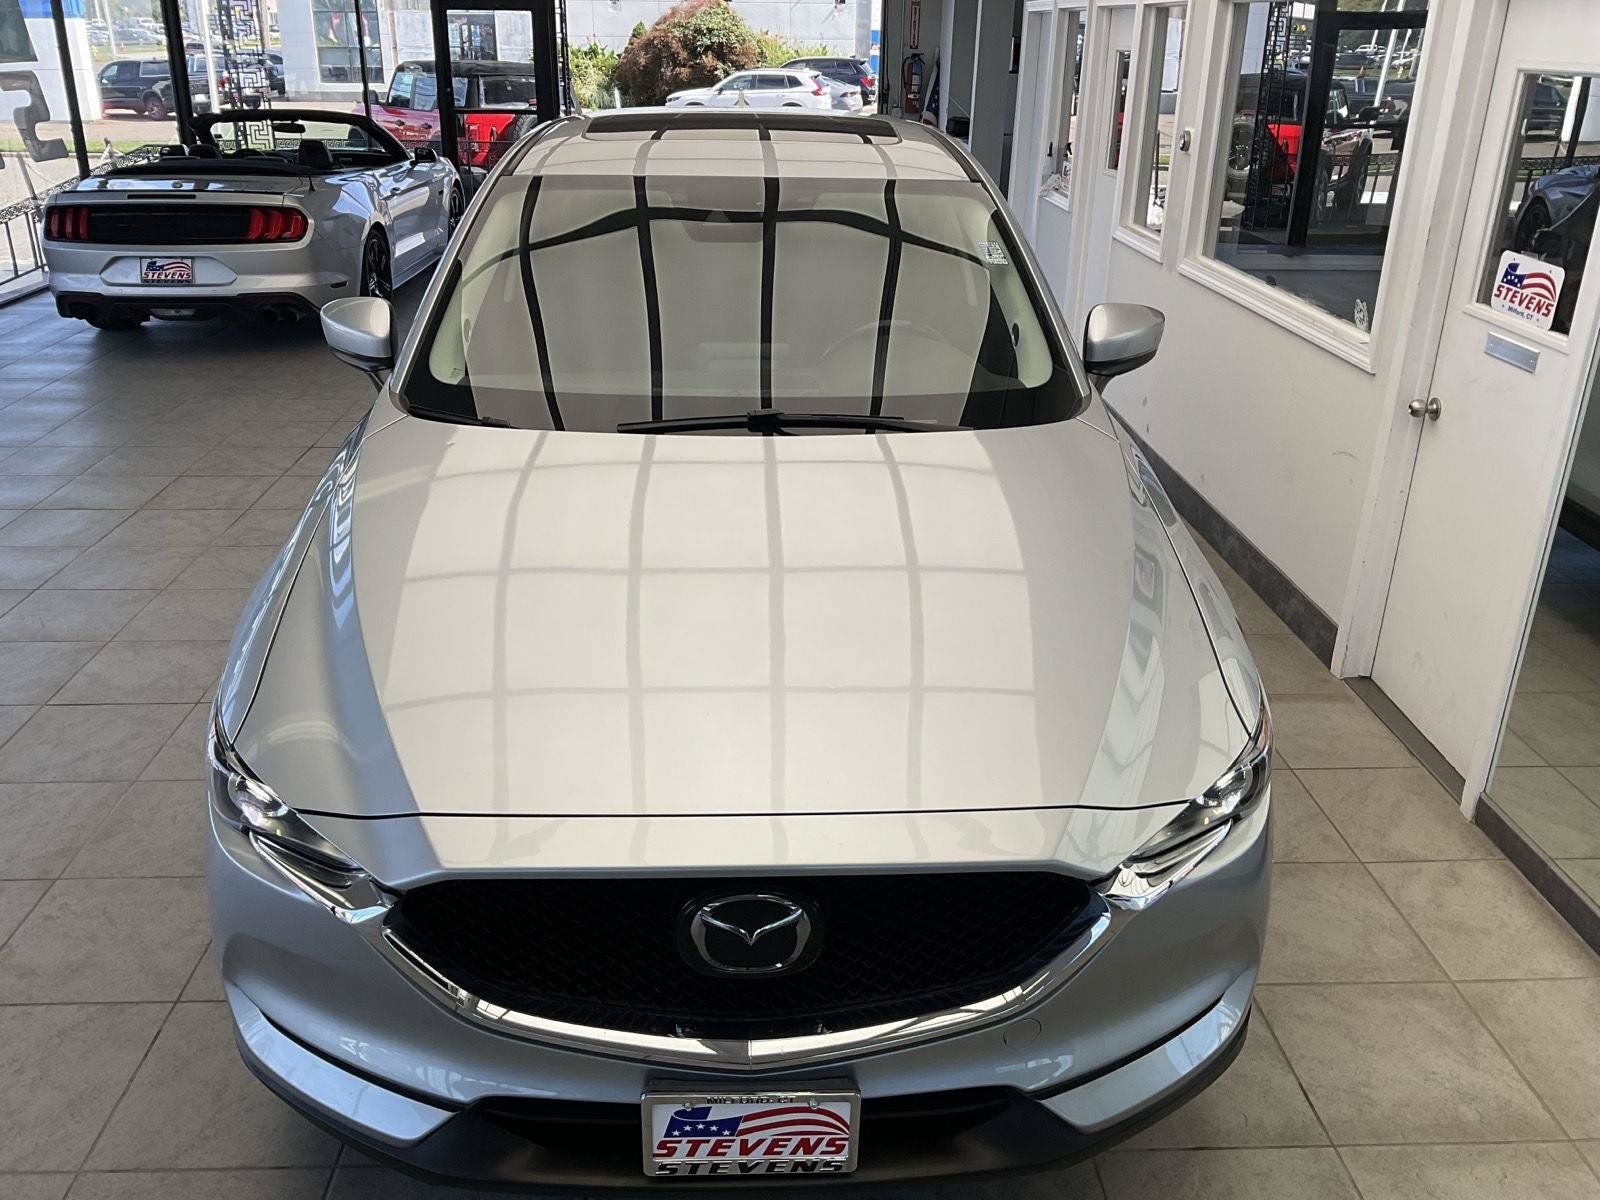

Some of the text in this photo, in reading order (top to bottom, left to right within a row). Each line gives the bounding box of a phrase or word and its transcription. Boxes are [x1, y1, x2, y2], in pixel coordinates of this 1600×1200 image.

[142, 271, 191, 279] STEVENS
[1494, 284, 1554, 317] STEVENS
[653, 1138, 849, 1157] STEVENS
[655, 1160, 844, 1175] STEVENS
